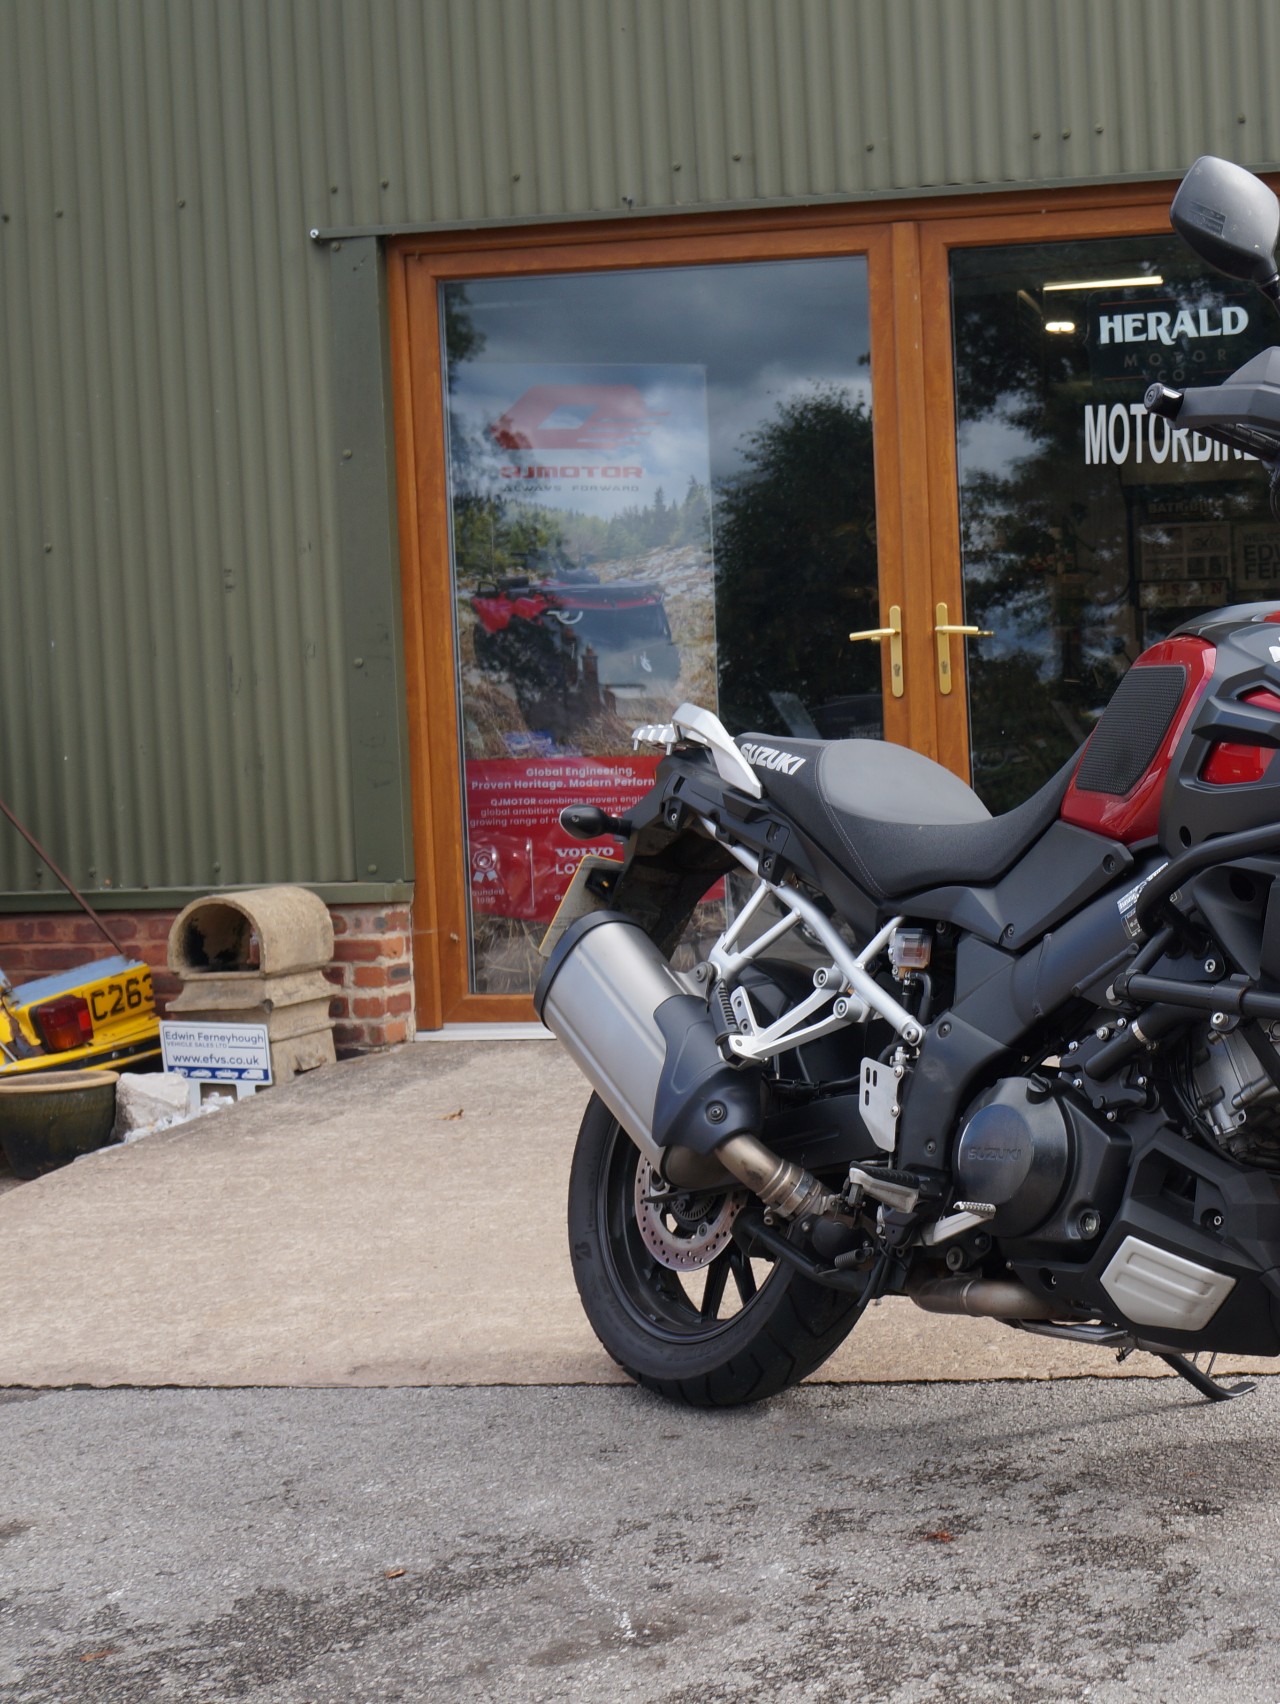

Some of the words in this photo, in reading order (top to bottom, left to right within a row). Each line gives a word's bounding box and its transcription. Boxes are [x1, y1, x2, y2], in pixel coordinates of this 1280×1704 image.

[1099, 306, 1249, 346] HERALD
[1124, 350, 1227, 368] MOTOR
[740, 743, 807, 776] SUZUKI
[526, 767, 563, 777] Global
[566, 766, 636, 778] Engineering.
[472, 781, 511, 790] Proven
[514, 779, 567, 790] Heritage.
[570, 778, 611, 788] Modern
[491, 798, 536, 807] QJMOTOR
[538, 796, 583, 805] combines
[586, 796, 618, 805] proven
[481, 807, 511, 817] global
[513, 806, 554, 815] ambition
[470, 818, 507, 828] growing
[510, 817, 537, 826] range
[540, 816, 549, 824] of
[555, 847, 614, 857] VOLVO
[165, 1031, 195, 1040] Edwin
[197, 1032, 264, 1045] Ferneyhough
[173, 1054, 259, 1065] www.efvs.co.uk
[967, 1146, 1022, 1160] SUZUKI
